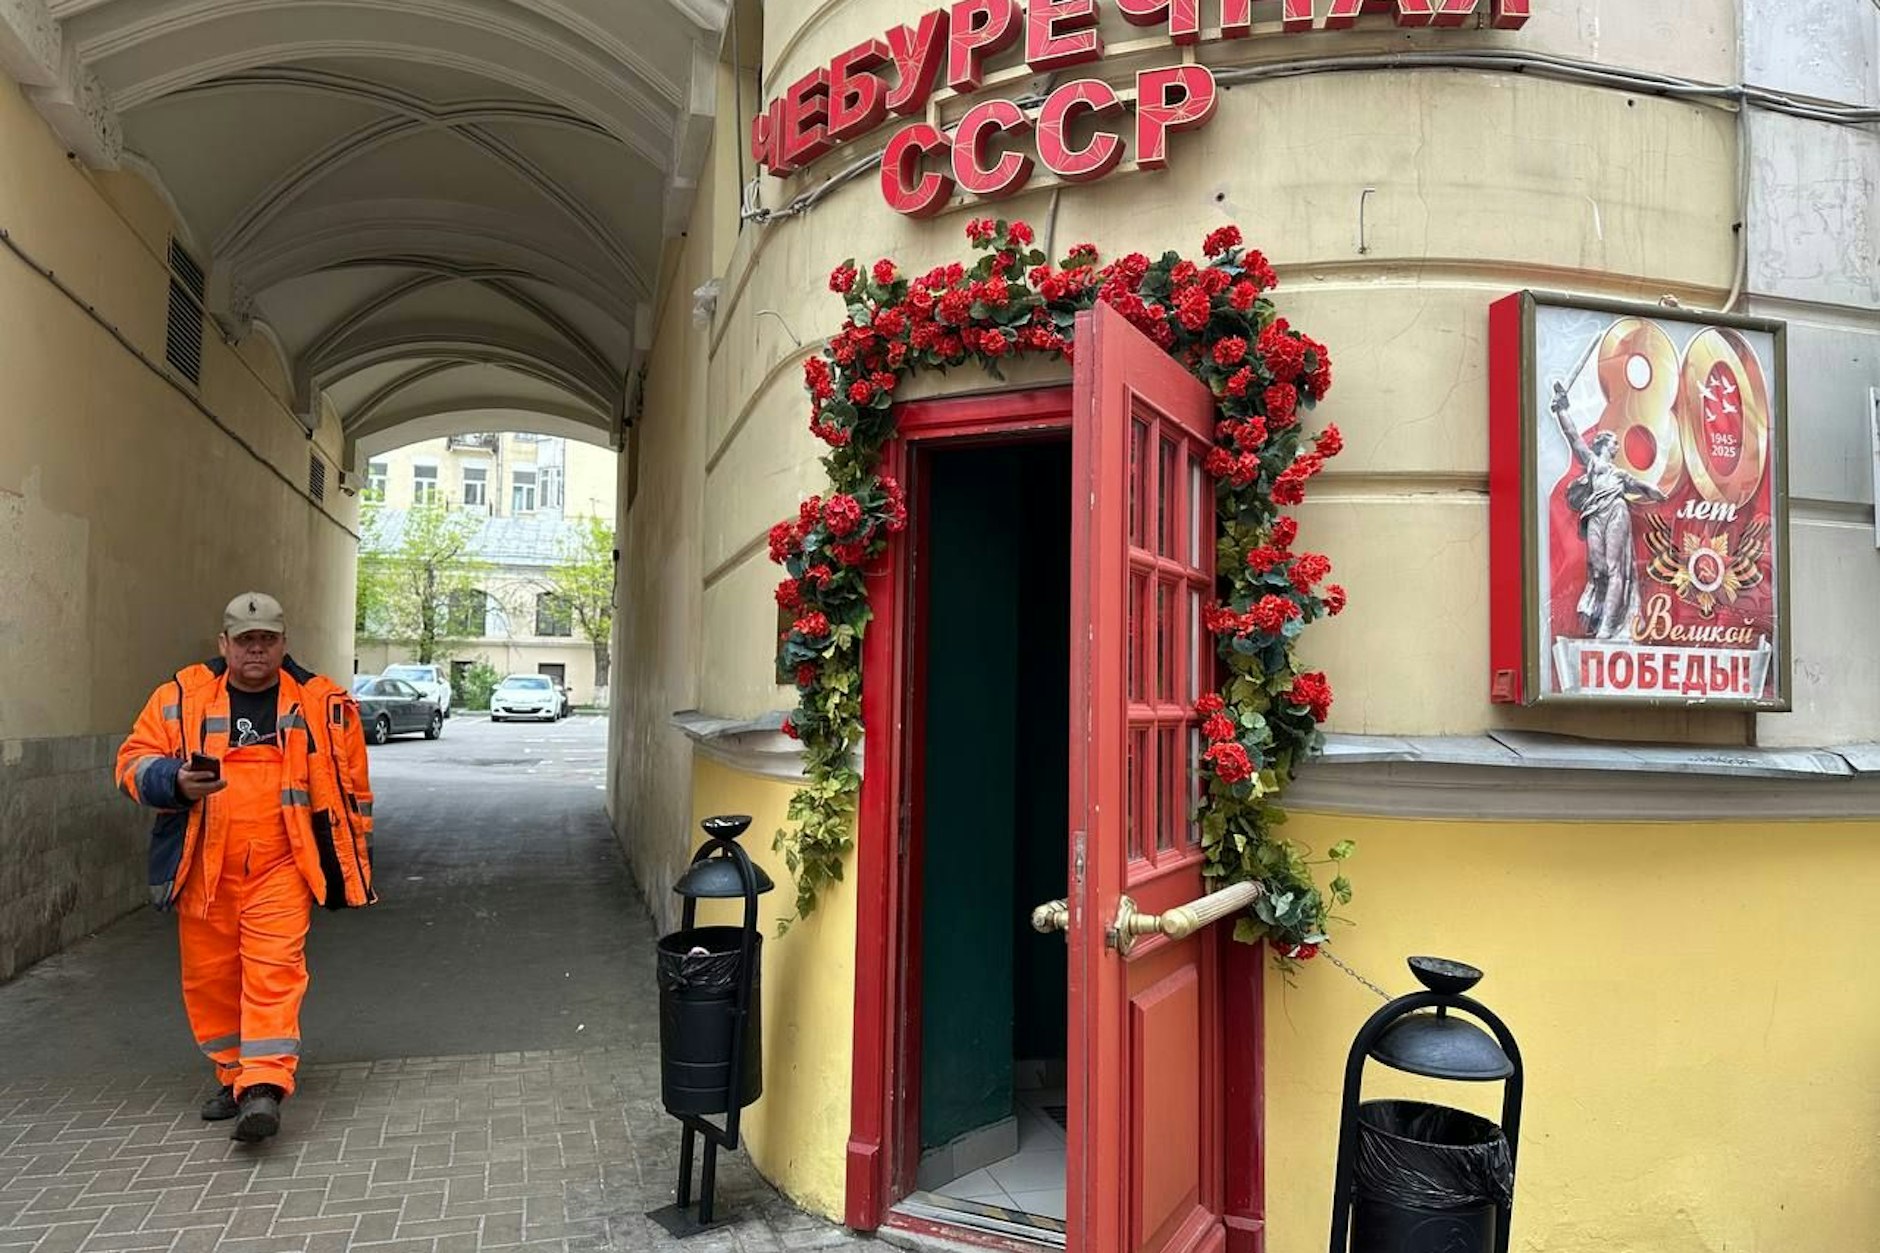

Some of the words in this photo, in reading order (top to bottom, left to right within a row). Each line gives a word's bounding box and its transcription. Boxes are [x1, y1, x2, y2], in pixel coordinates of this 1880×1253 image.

[752, 0, 1530, 178] ЧЕБУРЕ
[880, 63, 1218, 217] СССР
[1597, 316, 1770, 509] 80
[1711, 445, 1737, 458] 2025
[1676, 499, 1738, 522] лет
[1631, 593, 1755, 645] Великой
[1580, 650, 1751, 695] ПОБЕДЫ!
